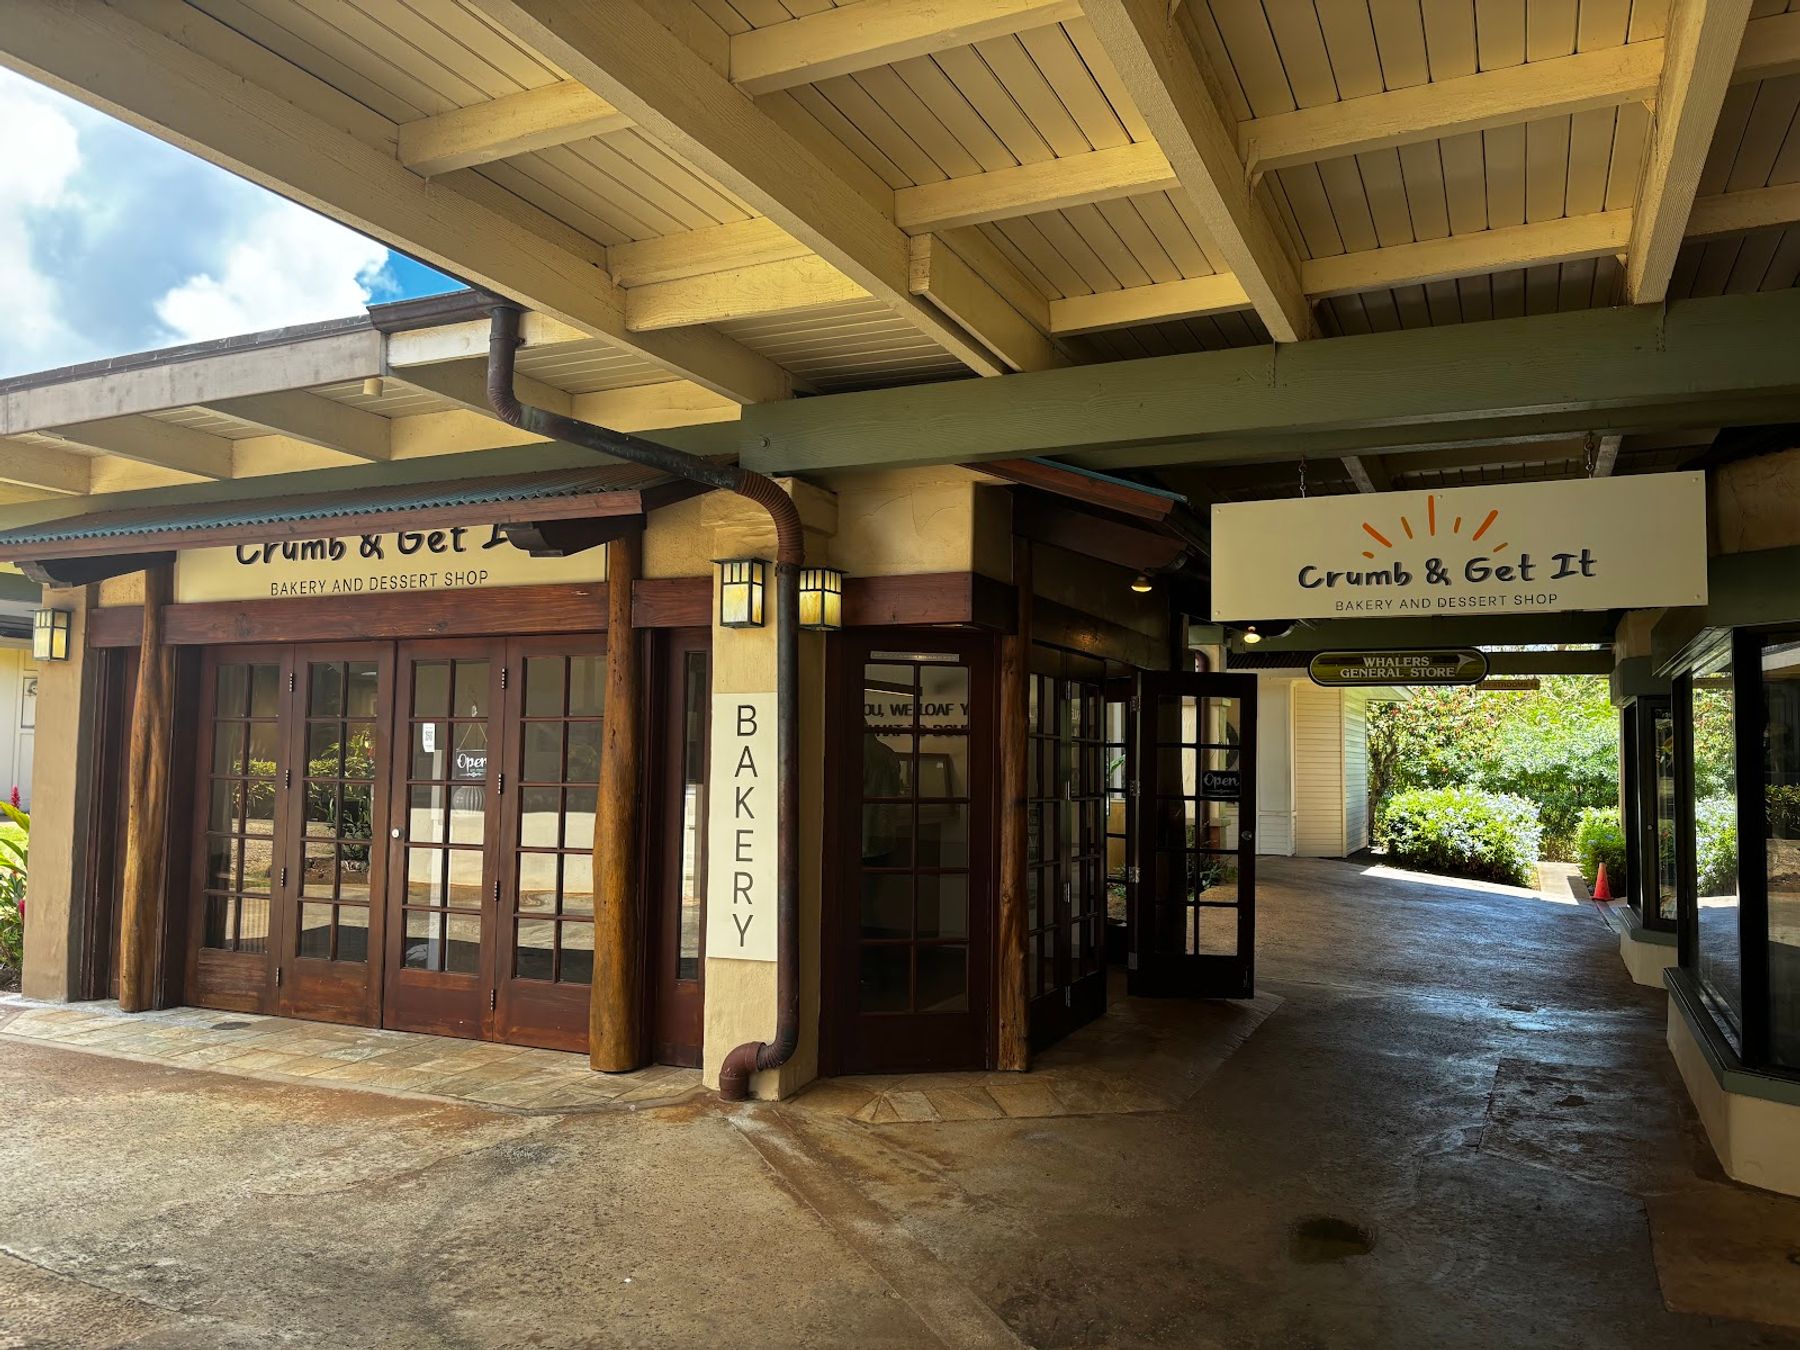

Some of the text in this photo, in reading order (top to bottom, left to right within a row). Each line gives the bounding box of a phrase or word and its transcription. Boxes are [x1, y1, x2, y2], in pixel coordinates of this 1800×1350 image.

[236, 538, 347, 564] Crumb
[360, 534, 384, 560] &
[397, 527, 468, 555] Get
[1298, 548, 1598, 589] Crumb & Get It
[270, 570, 489, 596] BAKERY AND DESSERT SHOP
[1335, 593, 1558, 612] BAKERY AND DESSERT SHOP
[1362, 656, 1430, 668] WHALERS
[1339, 667, 1456, 678] GENERAL STORE
[889, 703, 914, 717] WE
[919, 703, 955, 717] LOAF
[1203, 773, 1240, 790] Open
[732, 704, 759, 948] BAKERY
